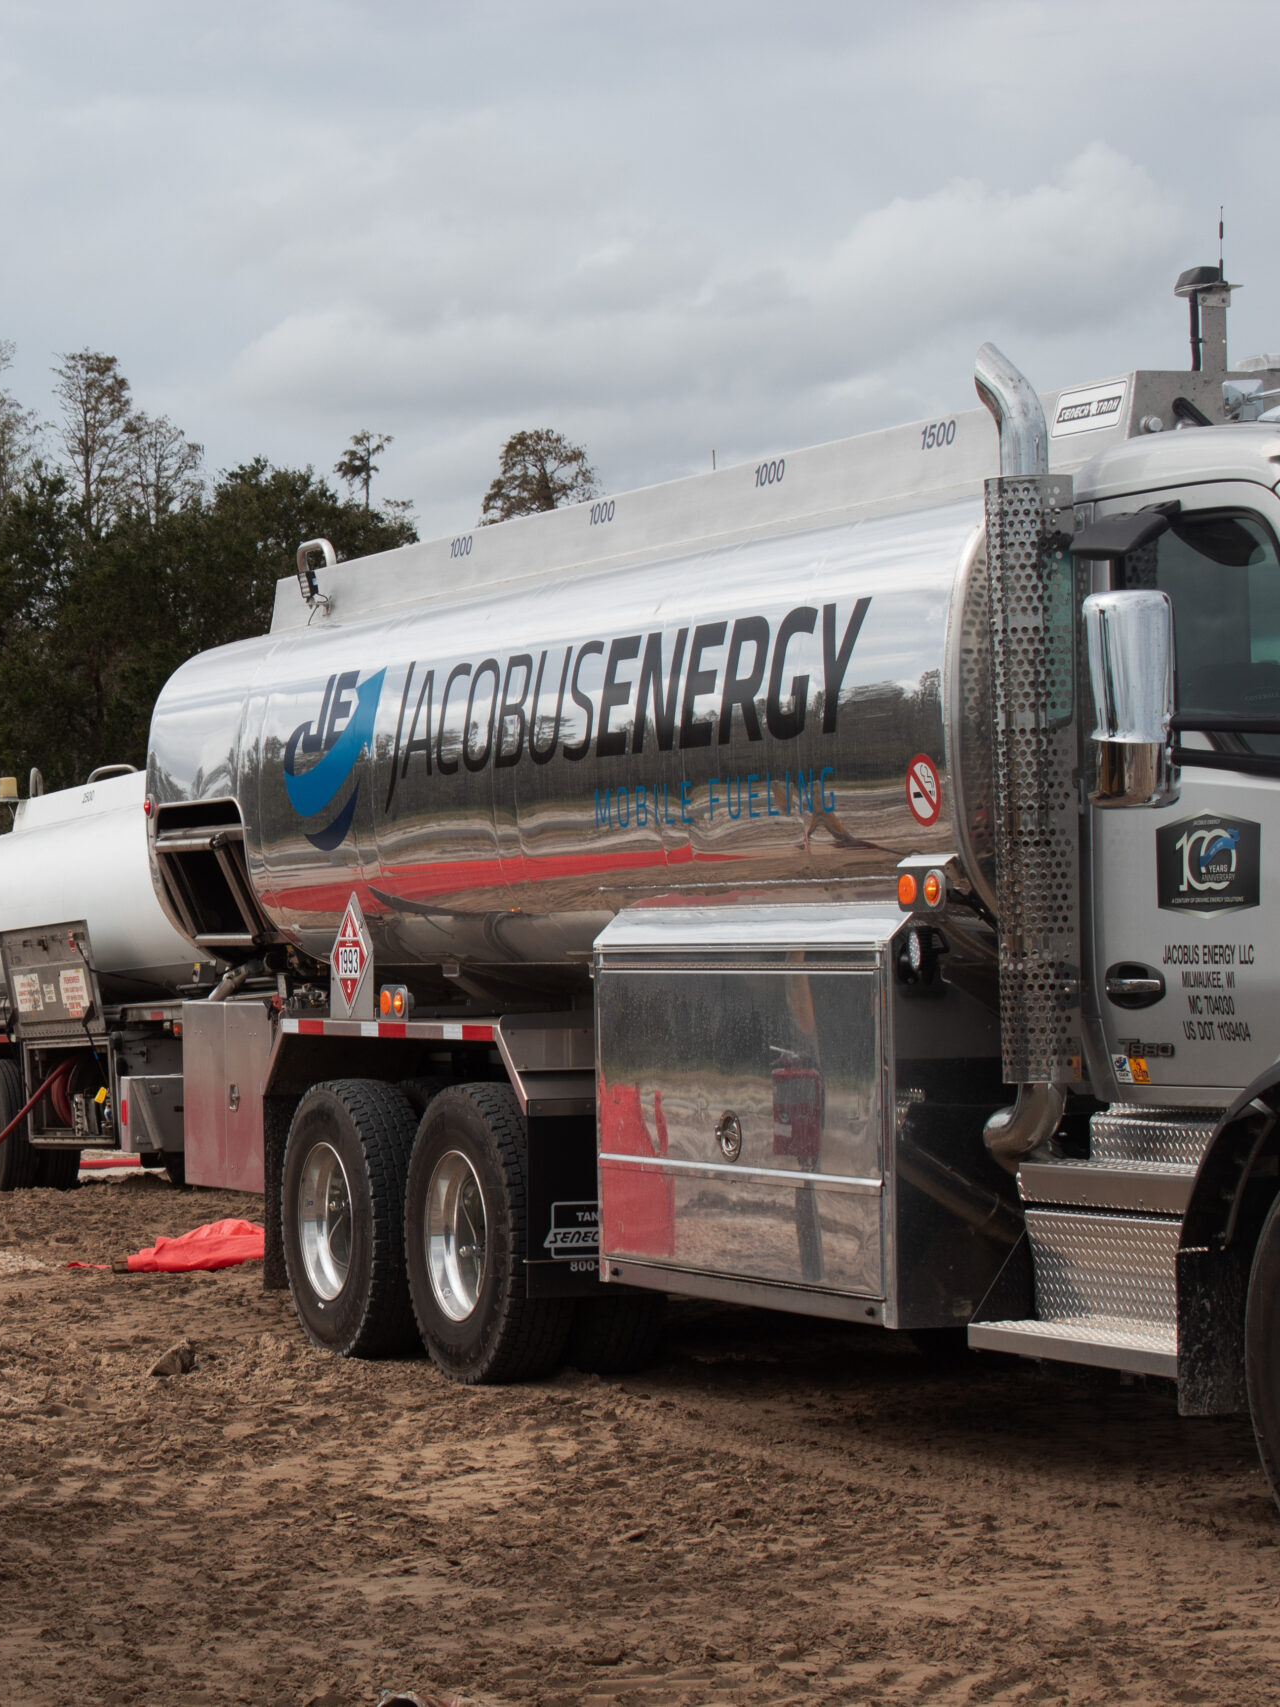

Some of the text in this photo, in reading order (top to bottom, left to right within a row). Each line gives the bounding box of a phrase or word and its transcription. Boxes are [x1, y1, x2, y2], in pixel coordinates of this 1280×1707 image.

[1058, 398, 1121, 422] SENECA TANK
[921, 420, 956, 450] 1500
[755, 458, 785, 488] 1000
[589, 500, 615, 526] 1000
[450, 535, 473, 559] 1000
[595, 767, 835, 829] MOBILE FUELING
[1201, 873, 1236, 881] ANNIVERSARY
[1209, 864, 1228, 873] YEARS
[340, 949, 359, 974] 1993
[1163, 944, 1254, 964] JACOBUS ENERGY LLC
[347, 980, 352, 993] 3
[1182, 971, 1236, 990] MILWAUKEE, WI
[1188, 995, 1235, 1015] MC 704030
[1183, 1021, 1251, 1041] US DOT 1139404
[1117, 1038, 1175, 1058] T880
